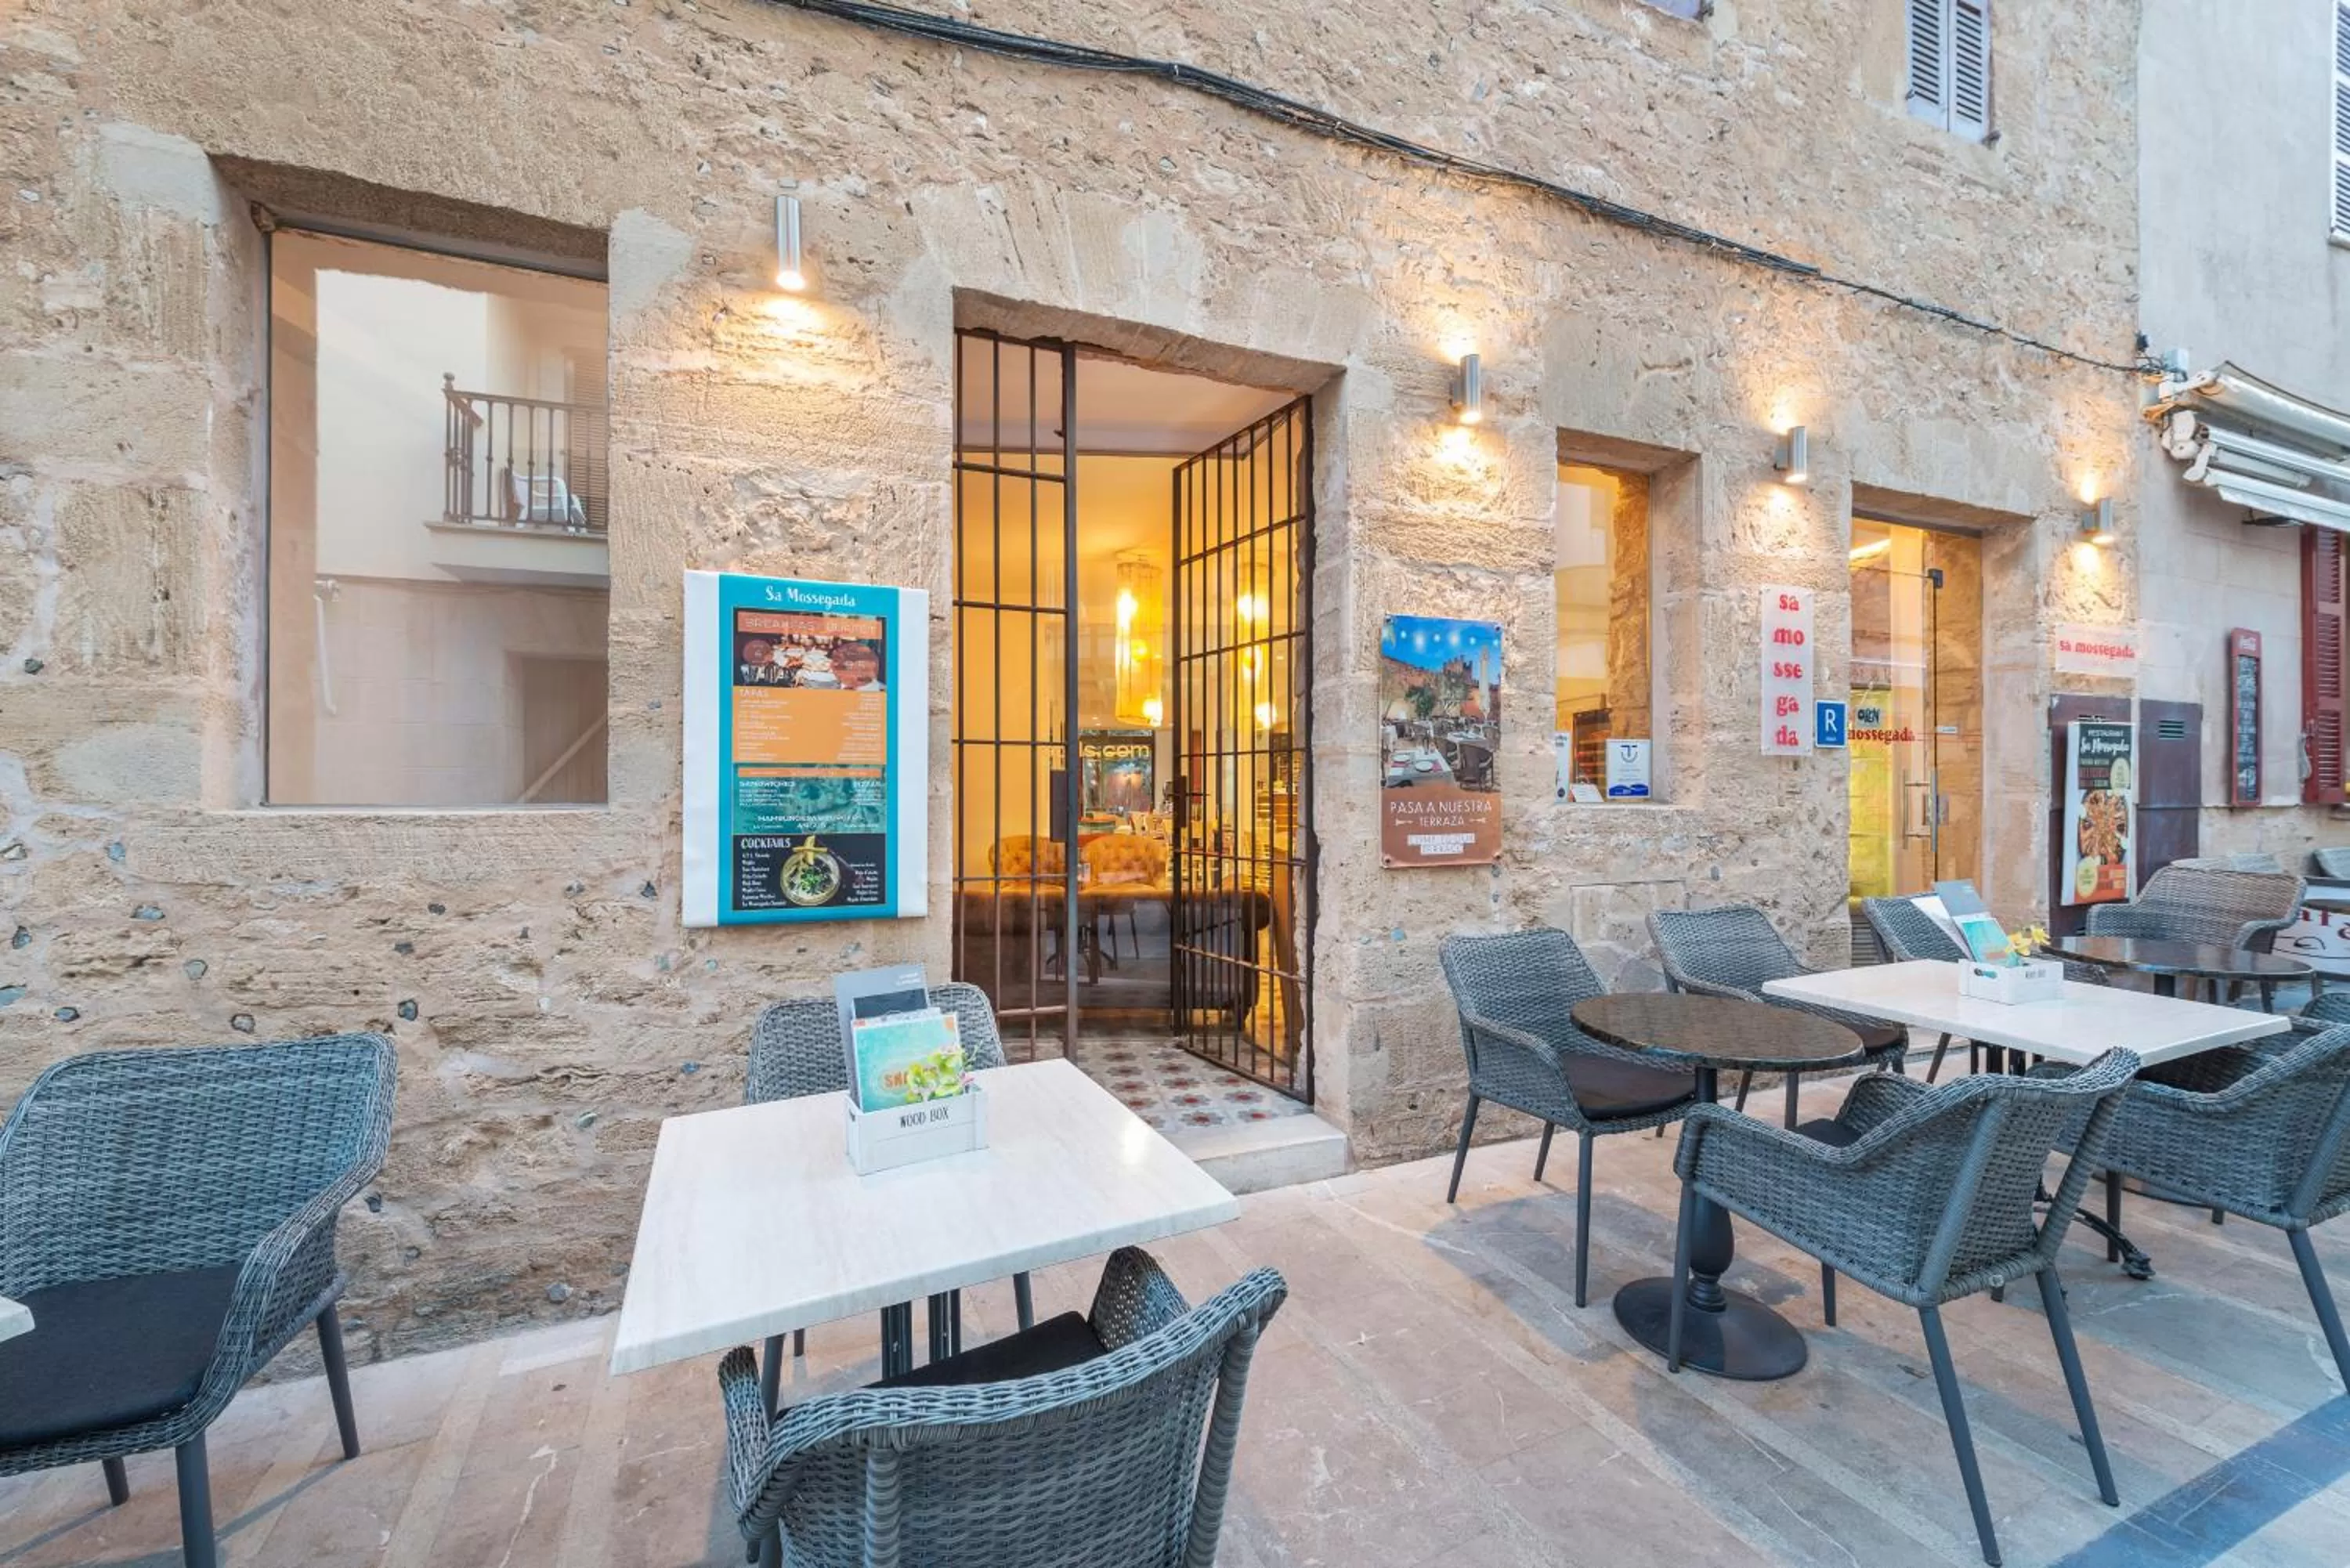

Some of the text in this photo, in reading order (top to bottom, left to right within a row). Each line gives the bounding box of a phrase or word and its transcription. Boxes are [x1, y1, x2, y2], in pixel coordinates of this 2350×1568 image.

[765, 586, 856, 609] Sa Mossegada
[1779, 594, 1799, 611] sa
[1773, 627, 1805, 645] mo
[2059, 640, 2135, 659] sa mossegada
[1773, 662, 1803, 678] sse
[1777, 695, 1799, 717] ga
[1824, 709, 1838, 733] R
[1775, 724, 1799, 746] da
[1390, 800, 1492, 814] PASA A NUESTRA
[1419, 815, 1464, 827] TERRAZA
[741, 837, 790, 850] COCKTAILS
[930, 1105, 949, 1122] BOX
